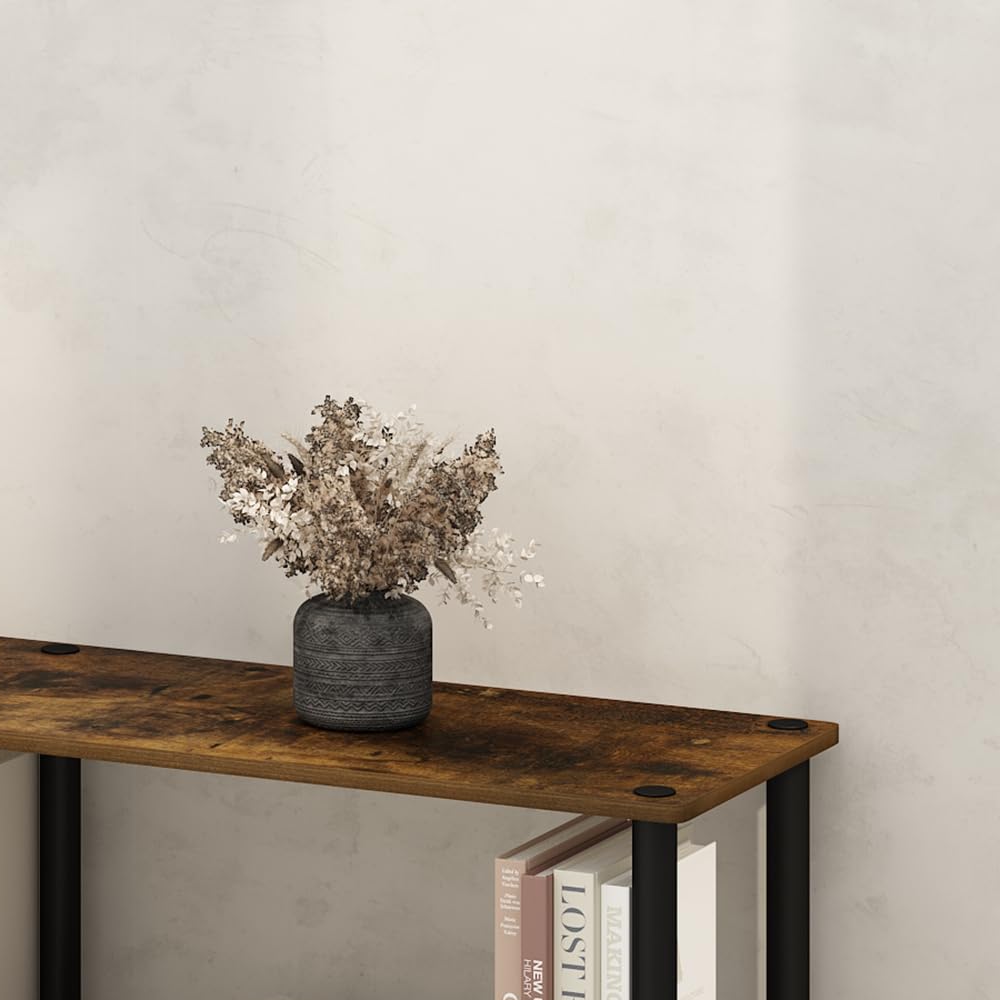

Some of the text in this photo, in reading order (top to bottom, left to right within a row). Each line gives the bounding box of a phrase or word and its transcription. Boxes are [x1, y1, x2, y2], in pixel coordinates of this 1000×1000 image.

[561, 885, 586, 980] LOST
[523, 959, 532, 998] HILARY
[533, 959, 543, 995] NEW
